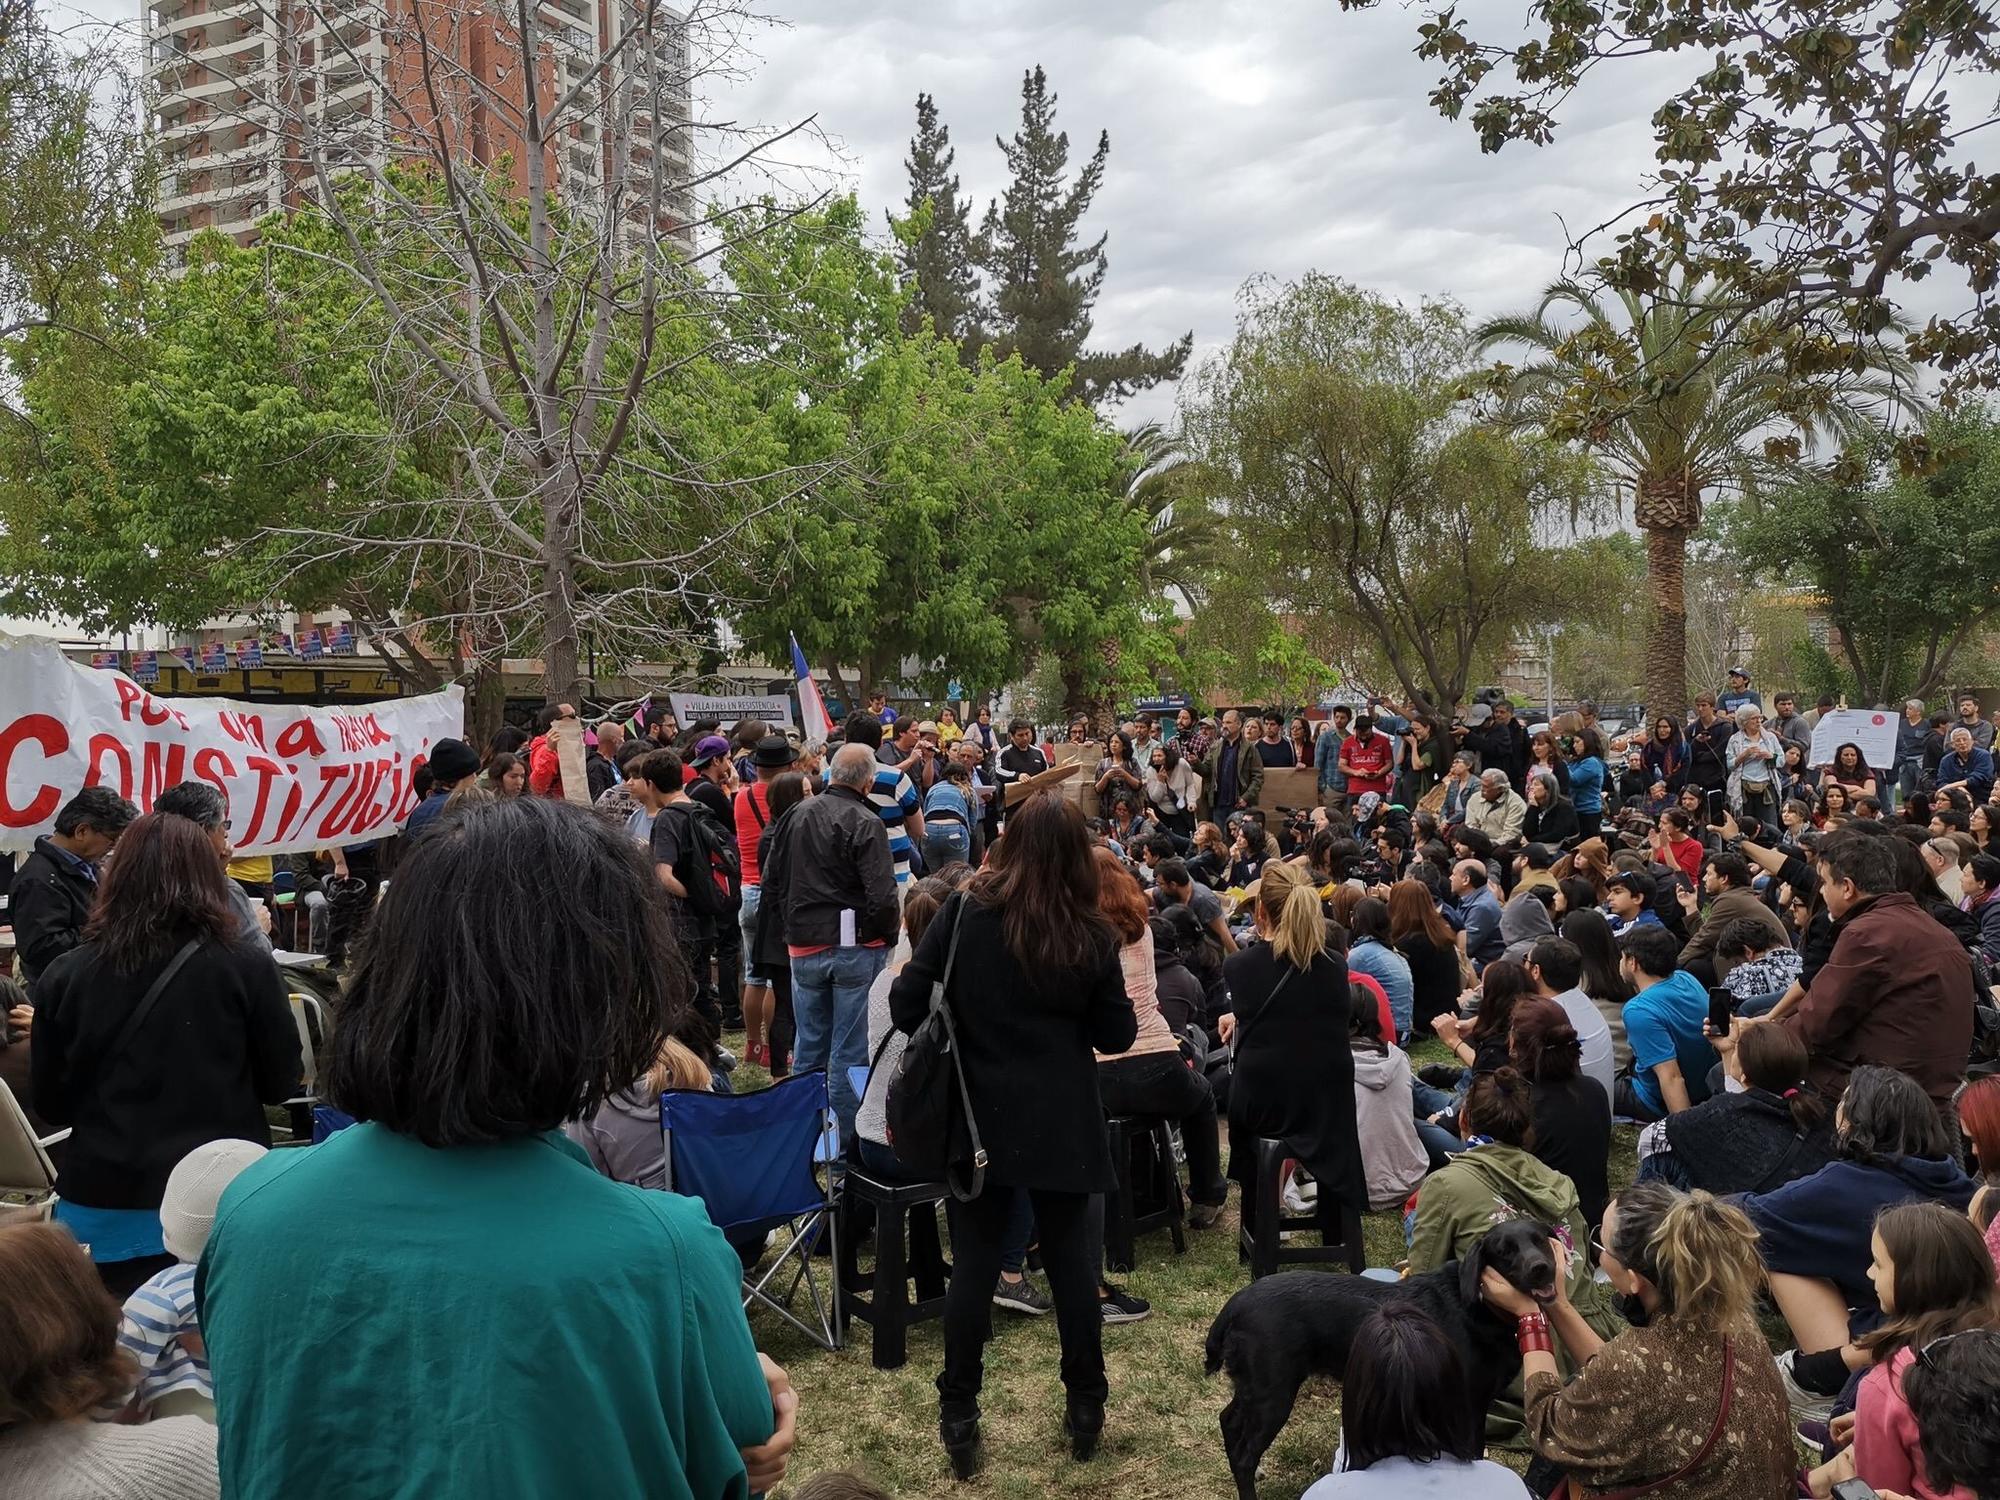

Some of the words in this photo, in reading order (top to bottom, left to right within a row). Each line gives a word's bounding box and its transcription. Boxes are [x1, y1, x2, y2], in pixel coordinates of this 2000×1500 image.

[691, 701, 710, 710] VILLA
[711, 701, 726, 710] FREI
[728, 701, 737, 710] EN
[738, 701, 776, 710] RESISTENCIA
[218, 711, 327, 758] una
